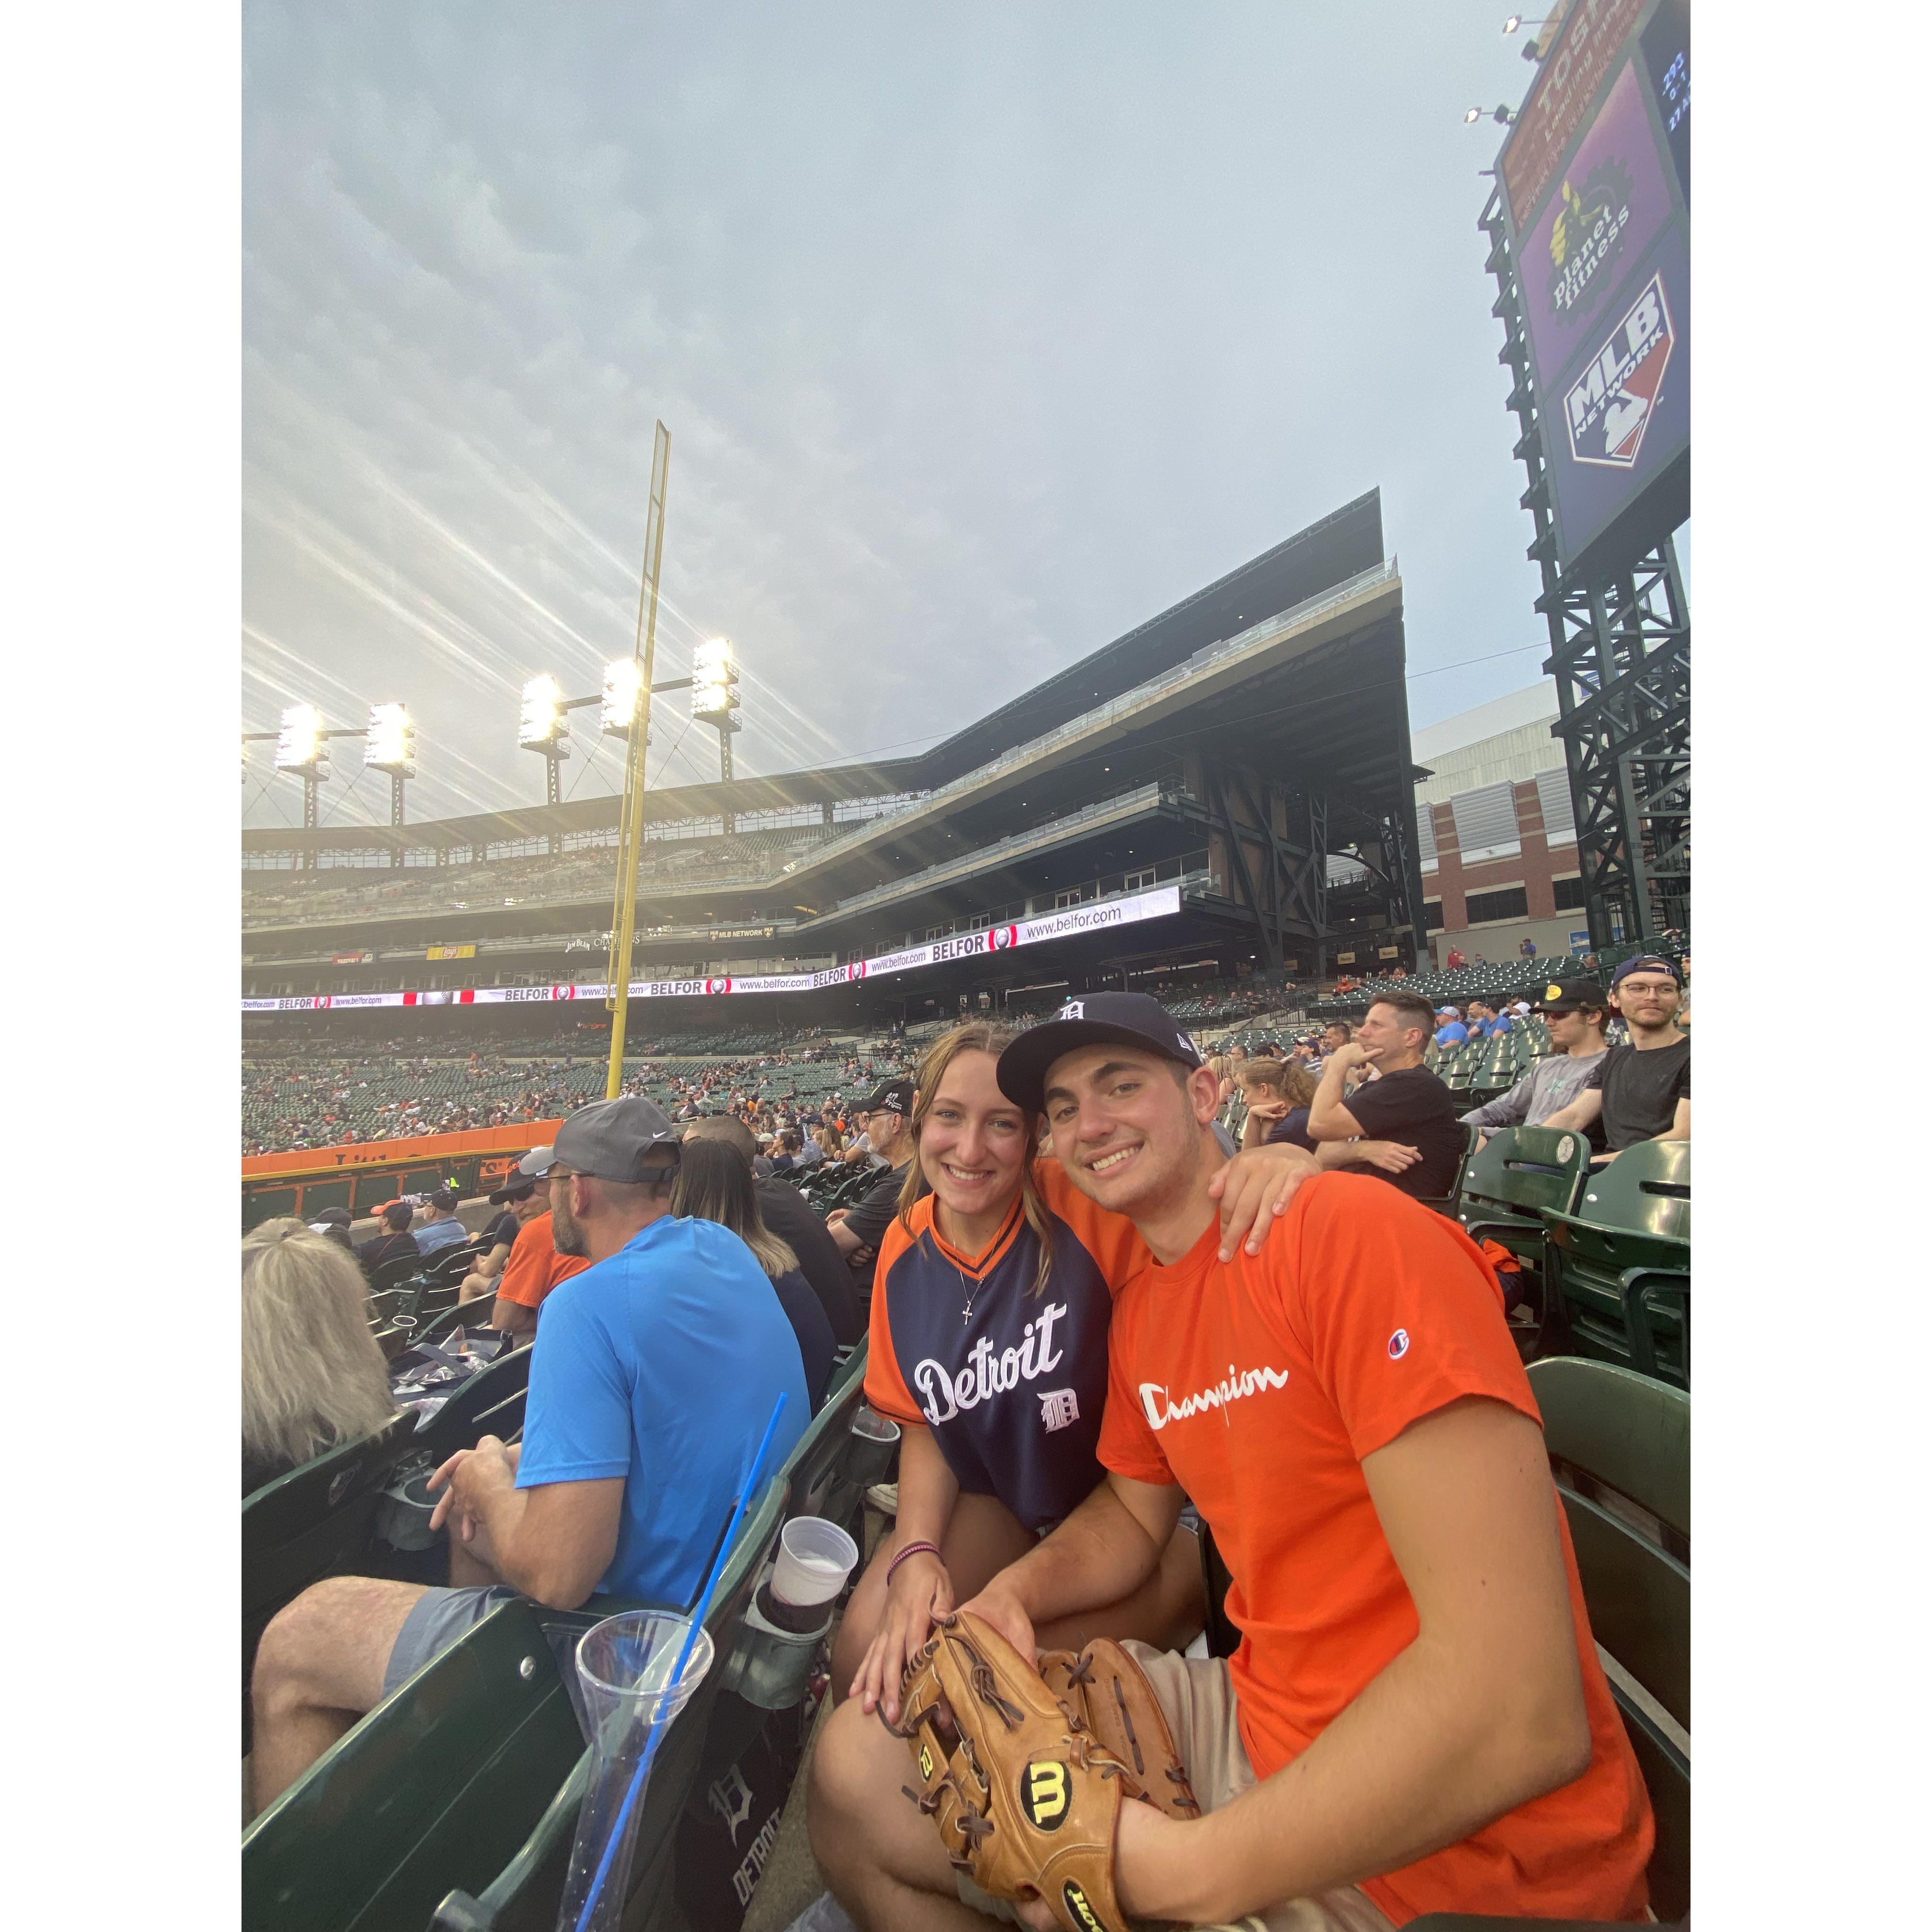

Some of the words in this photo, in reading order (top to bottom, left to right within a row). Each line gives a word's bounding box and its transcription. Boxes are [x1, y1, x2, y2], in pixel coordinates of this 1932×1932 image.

[1554, 204, 1611, 310] planet
[1565, 205, 1629, 310] fitness
[1569, 291, 1659, 428] MLB
[1576, 326, 1663, 439] NETWORK
[505, 988, 550, 1001] BELFOR
[651, 981, 702, 995] BELFOR
[740, 978, 810, 990] www.belfor.com
[813, 967, 846, 987] BELFOR
[872, 951, 926, 972] www.belfor.com
[933, 935, 984, 962] BELFOR
[1027, 907, 1121, 938] www.belfor.com
[565, 941, 575, 953] JIM
[576, 939, 590, 951] BEAM
[733, 929, 763, 937] NETWORK
[279, 998, 312, 1009] BELFOR
[336, 996, 382, 1006] www.belfor.com
[914, 1302, 1067, 1426] Detroit
[1139, 1364, 1289, 1430] Champion
[733, 1806, 780, 1907] DETROIT
